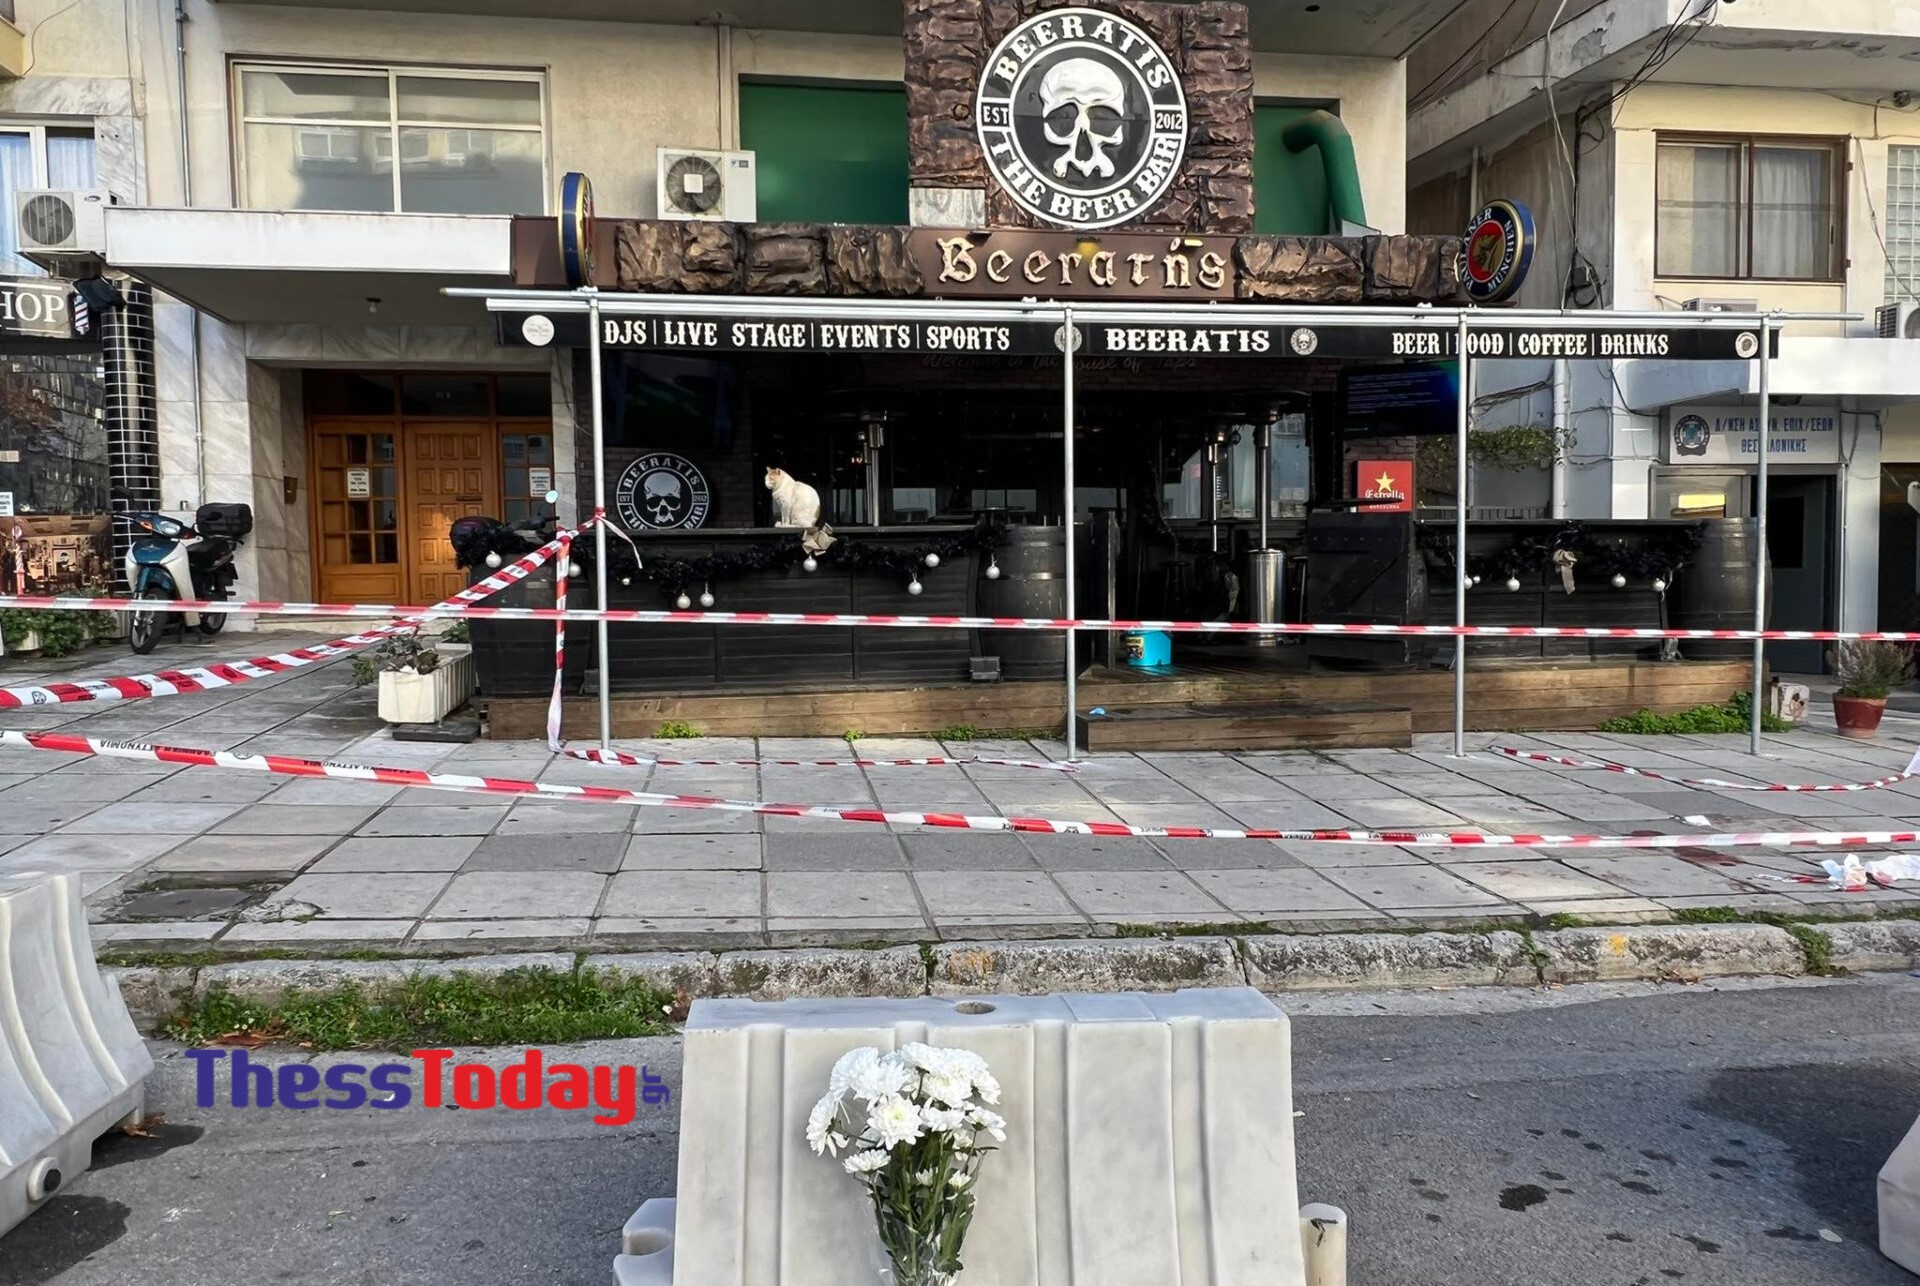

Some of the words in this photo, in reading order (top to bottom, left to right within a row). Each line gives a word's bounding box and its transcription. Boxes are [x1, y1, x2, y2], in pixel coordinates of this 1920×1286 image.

[993, 15, 1172, 89] BEERATIS
[983, 106, 1009, 124] EST
[1156, 113, 1182, 130] 2012
[990, 131, 1046, 206] THE
[1050, 188, 1138, 221] BEER
[1134, 137, 1181, 197] BAR
[604, 320, 647, 345] DJS
[663, 321, 718, 346] LIVE
[731, 322, 806, 348] STAGE
[821, 324, 911, 349] EVENTS
[926, 326, 1010, 350] SPORTS
[1104, 328, 1270, 352] BEERATIS
[1392, 332, 1440, 355] BEER
[1518, 333, 1588, 356] COFFEE
[1600, 333, 1669, 356] DRINKS
[1075, 358, 1118, 370] ouse
[1741, 438, 1806, 453] ΘΕΣΛΟΝΙΚΗΣ
[622, 457, 701, 489] BEERATIS
